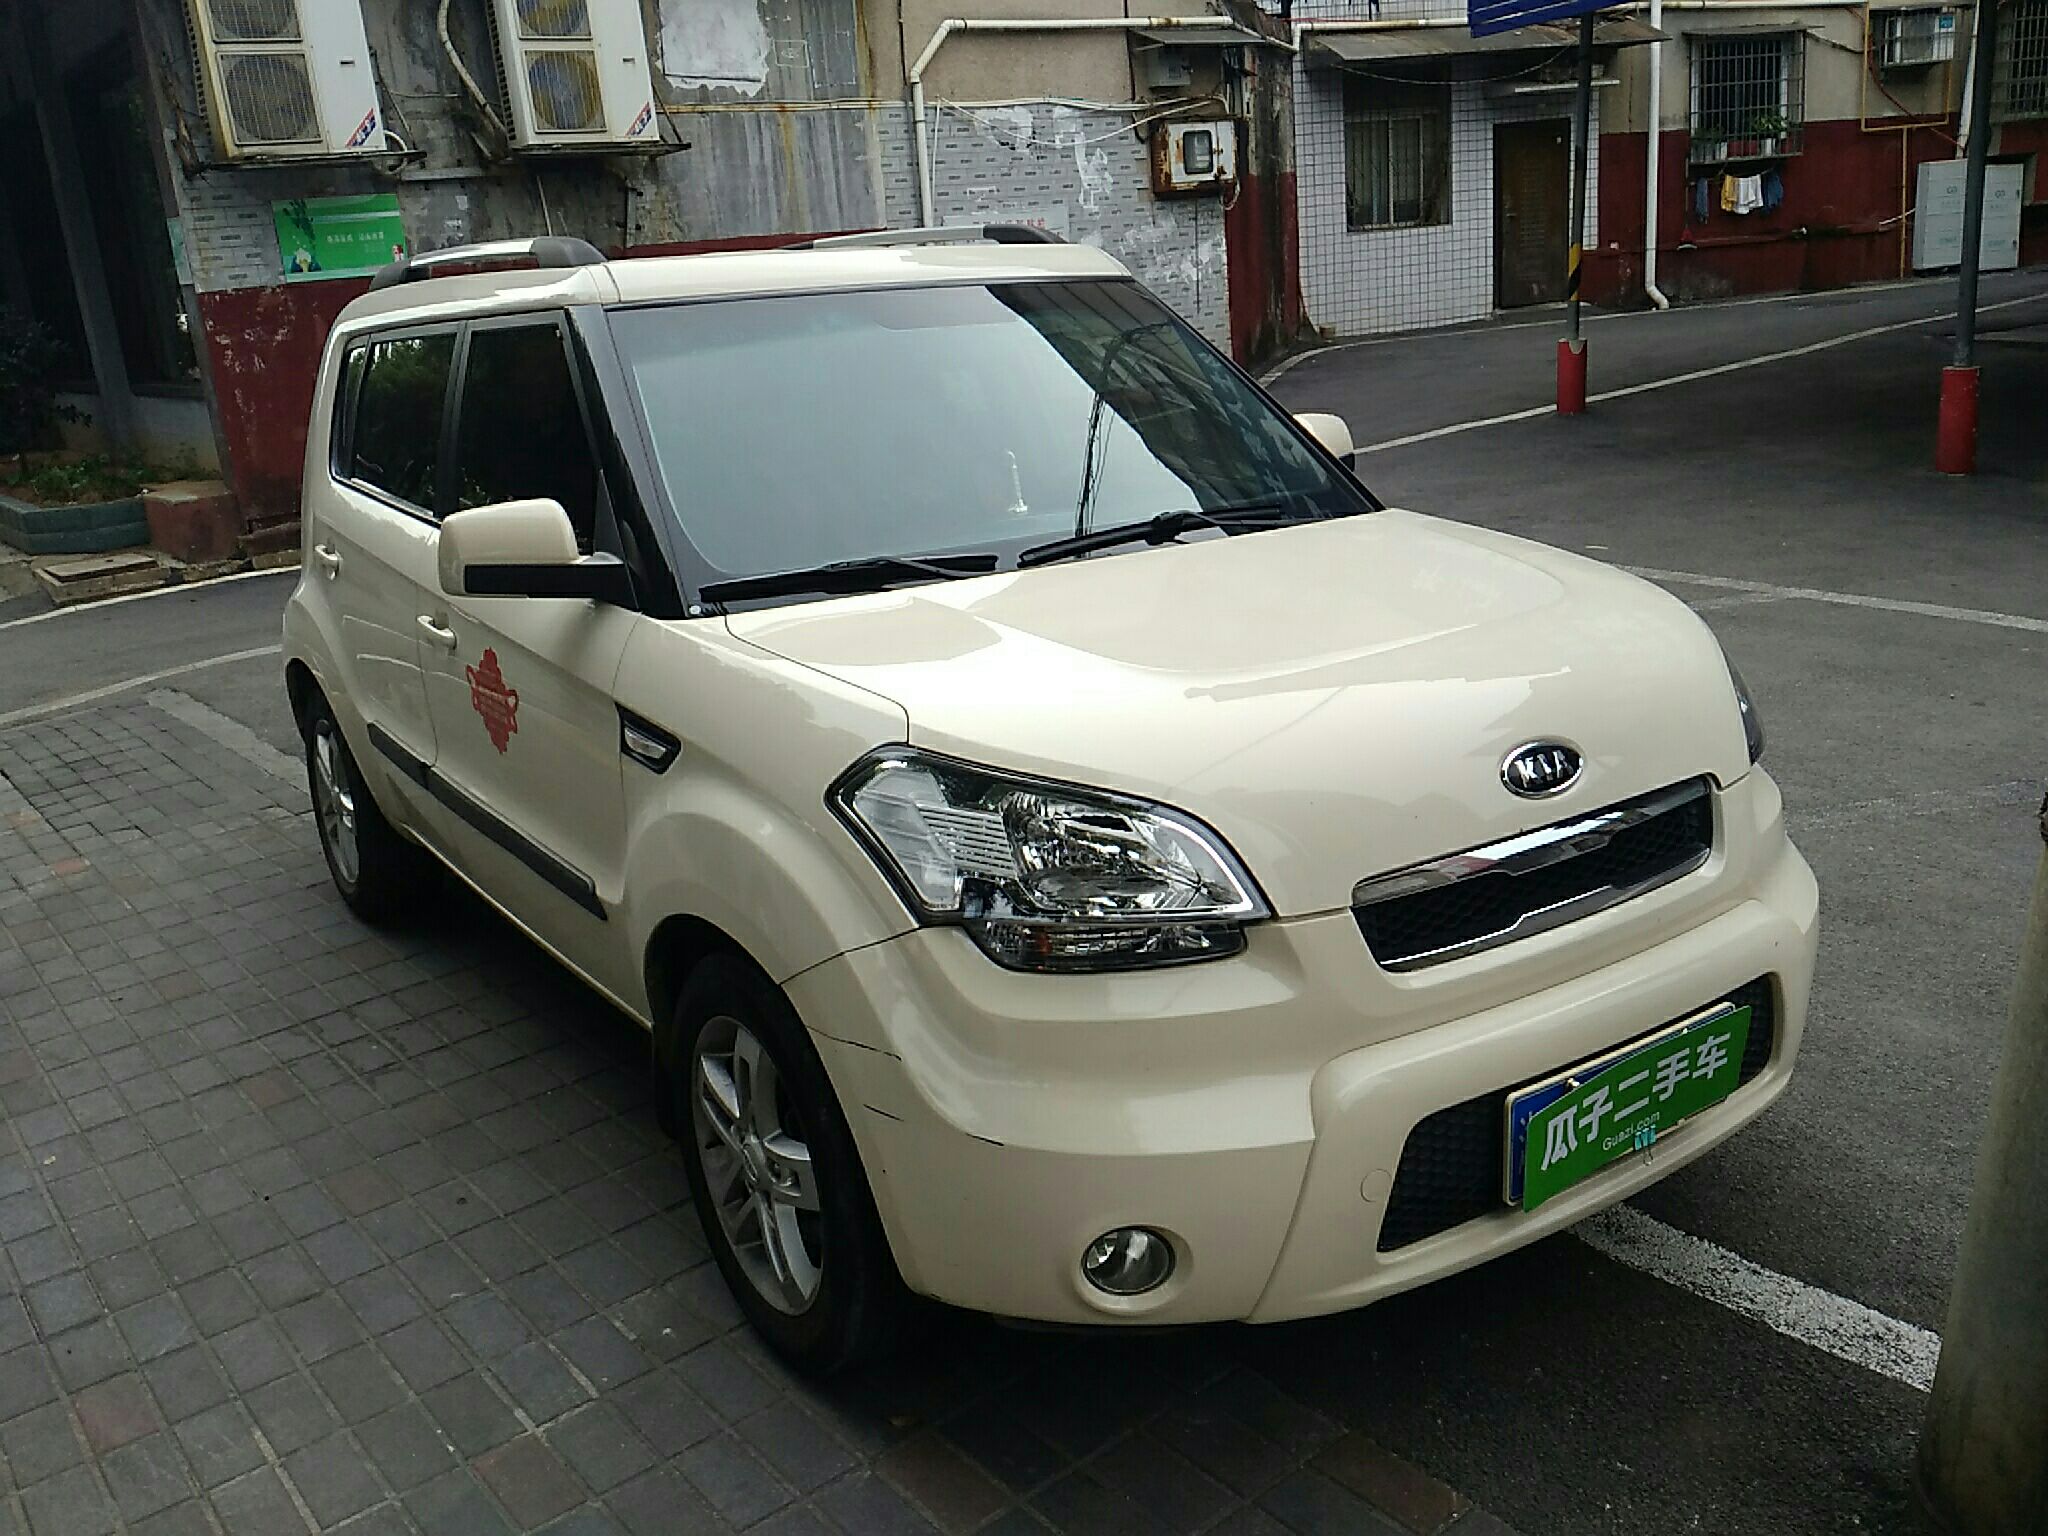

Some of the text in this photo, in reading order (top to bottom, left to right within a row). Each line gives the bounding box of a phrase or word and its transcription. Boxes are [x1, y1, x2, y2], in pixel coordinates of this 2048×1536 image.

[1540, 1032, 1731, 1171] 瓜子二手车
[1602, 1111, 1660, 1151] Guazi.com
